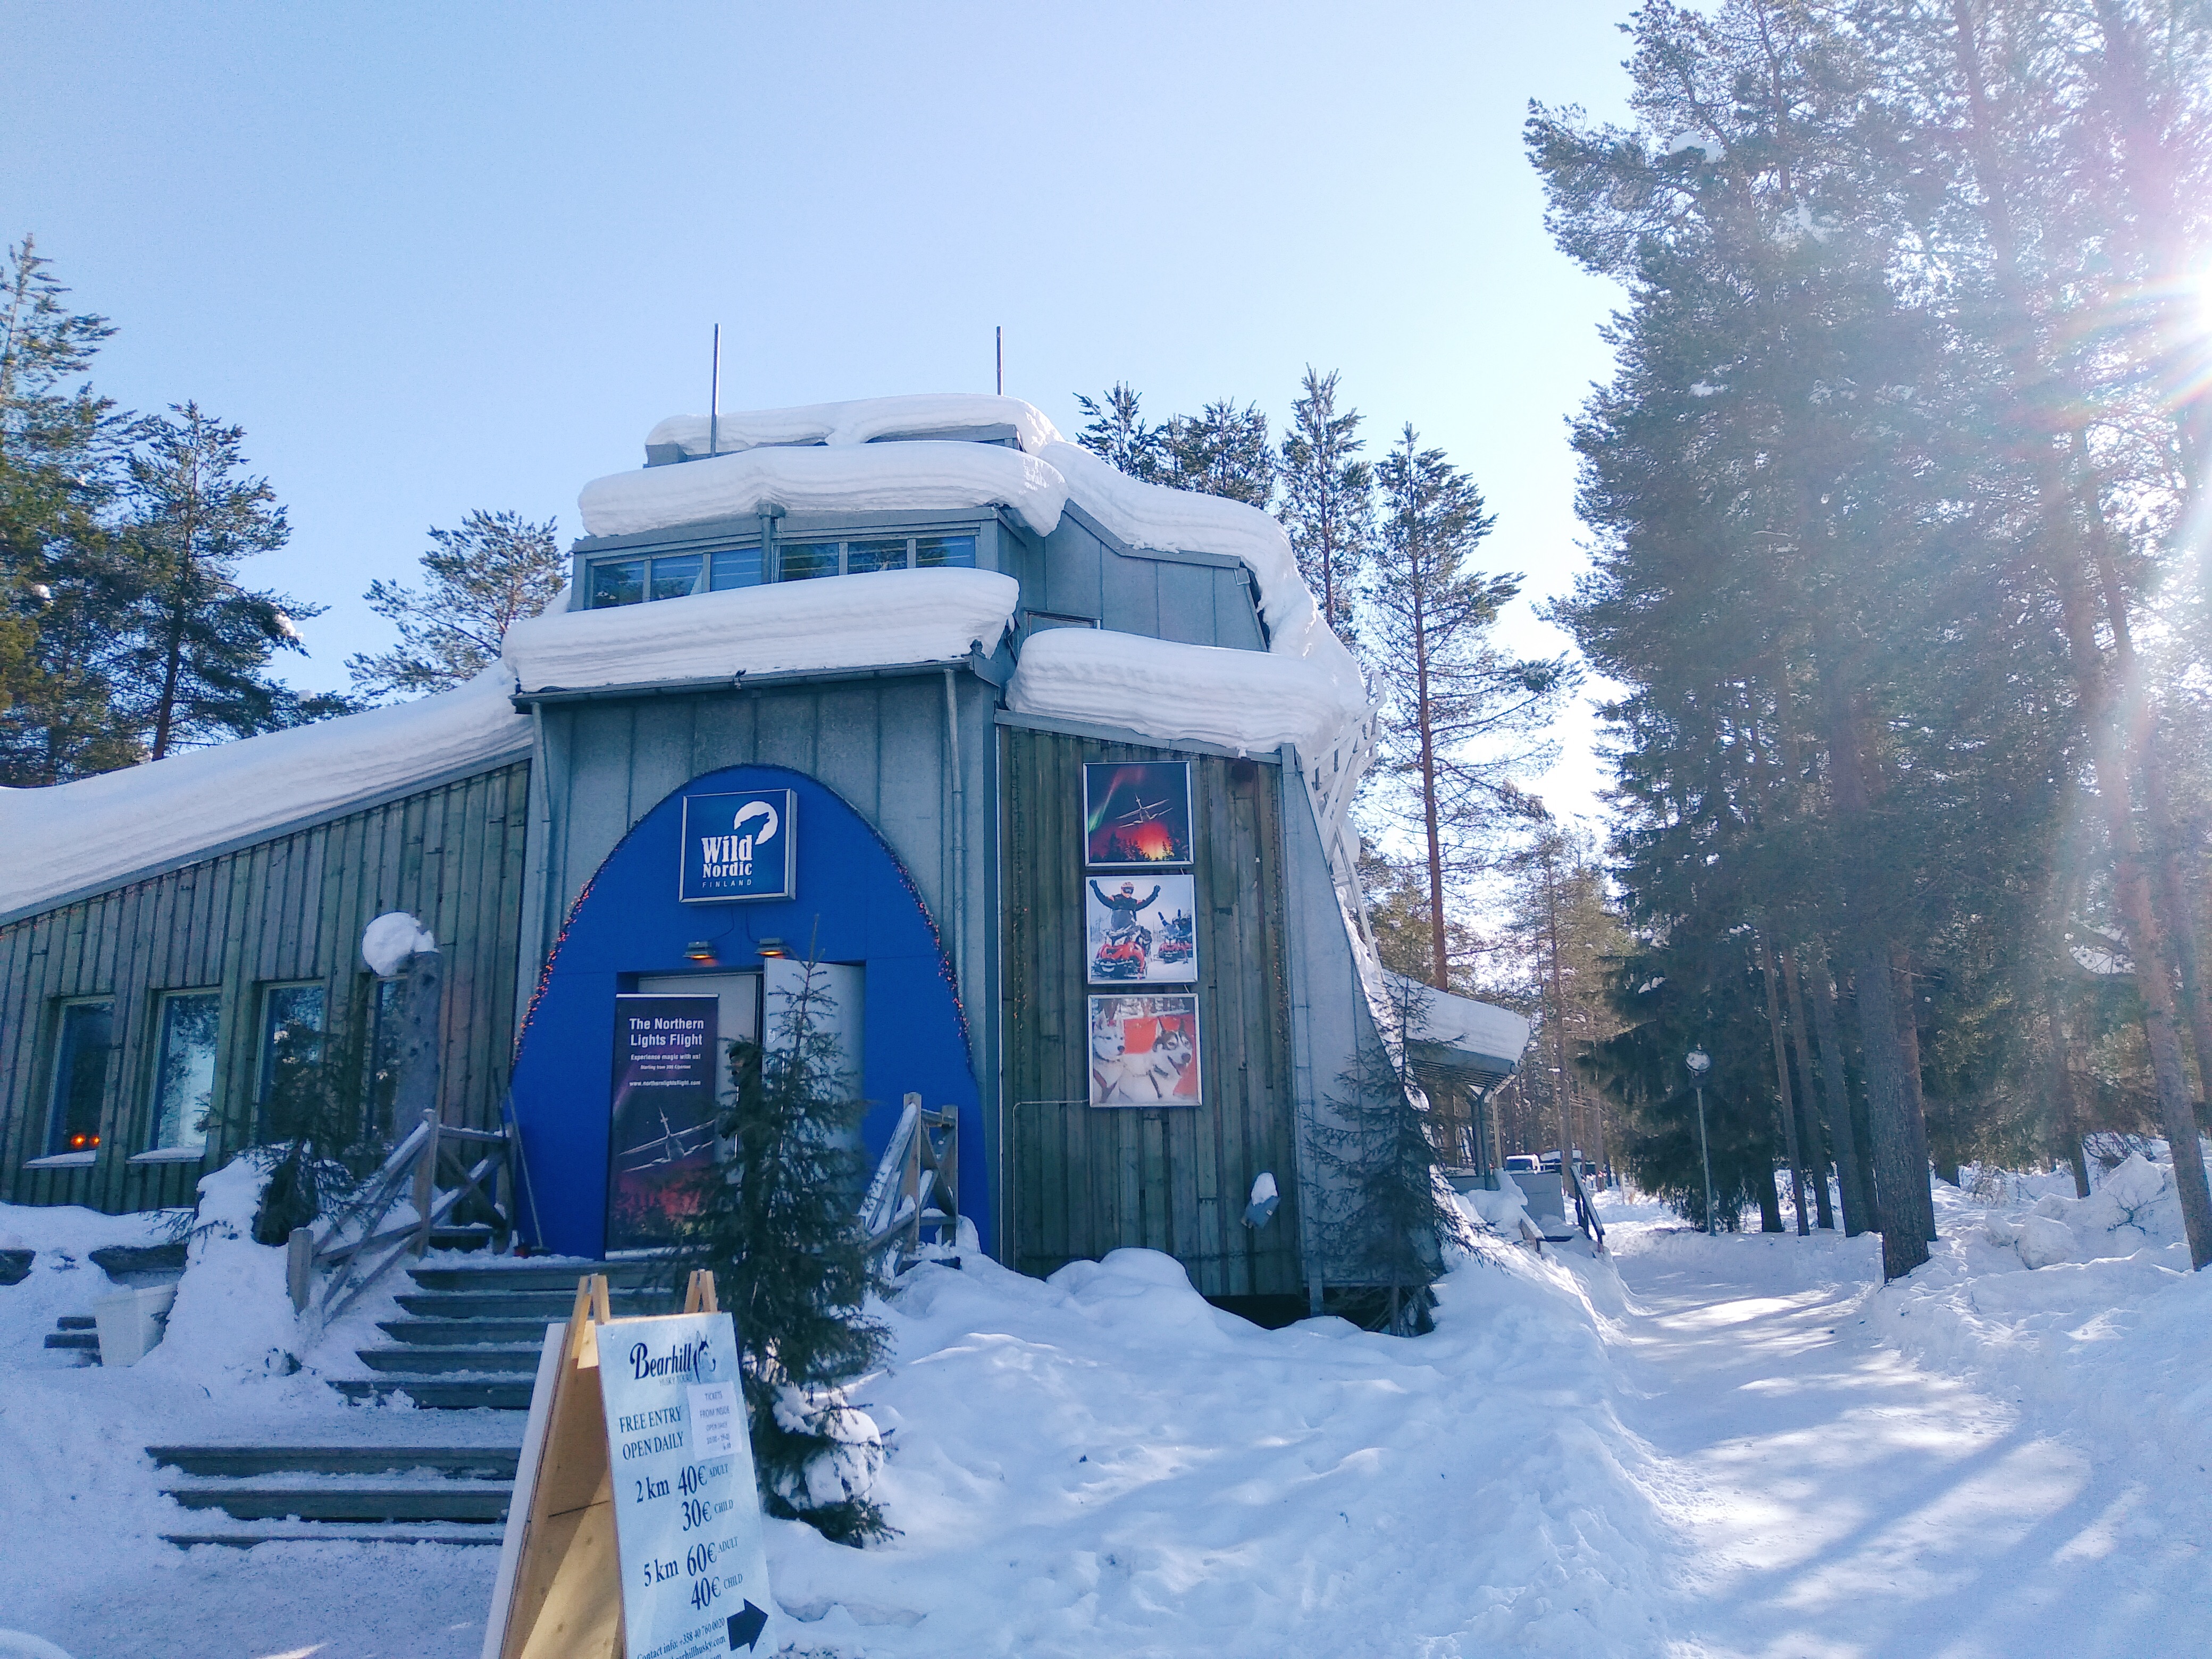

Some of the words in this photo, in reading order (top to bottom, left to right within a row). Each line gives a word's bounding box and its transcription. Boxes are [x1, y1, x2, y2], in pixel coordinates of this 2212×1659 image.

[701, 834, 752, 864] Wild
[702, 861, 752, 878] Nordic
[702, 879, 751, 888] FINLAND
[629, 1018, 651, 1030] The
[654, 1017, 705, 1030] Northern
[631, 1034, 666, 1048] Lights
[669, 1033, 703, 1048] Flight
[630, 1343, 692, 1380] Bearhill
[619, 1413, 647, 1433] FREE
[648, 1405, 681, 1427] ENTRY
[623, 1439, 652, 1461] OPEN
[653, 1431, 683, 1453] DAILY
[635, 1480, 643, 1503] 2
[646, 1476, 670, 1500] km
[678, 1465, 707, 1496] 40€
[709, 1463, 728, 1478] ADULT
[681, 1498, 711, 1531] 30€
[714, 1499, 733, 1514] CHILD
[644, 1562, 651, 1587] 5
[654, 1557, 679, 1583] km
[687, 1542, 717, 1577] 60€
[718, 1537, 738, 1553] ADULT
[691, 1577, 721, 1610] 40€
[724, 1573, 743, 1589] CHILD
[663, 1639, 678, 1654] info:
[680, 1631, 693, 1645] +358
[694, 1628, 701, 1639] 40
[701, 1622, 711, 1636] 760
[712, 1617, 725, 1631] 0020
